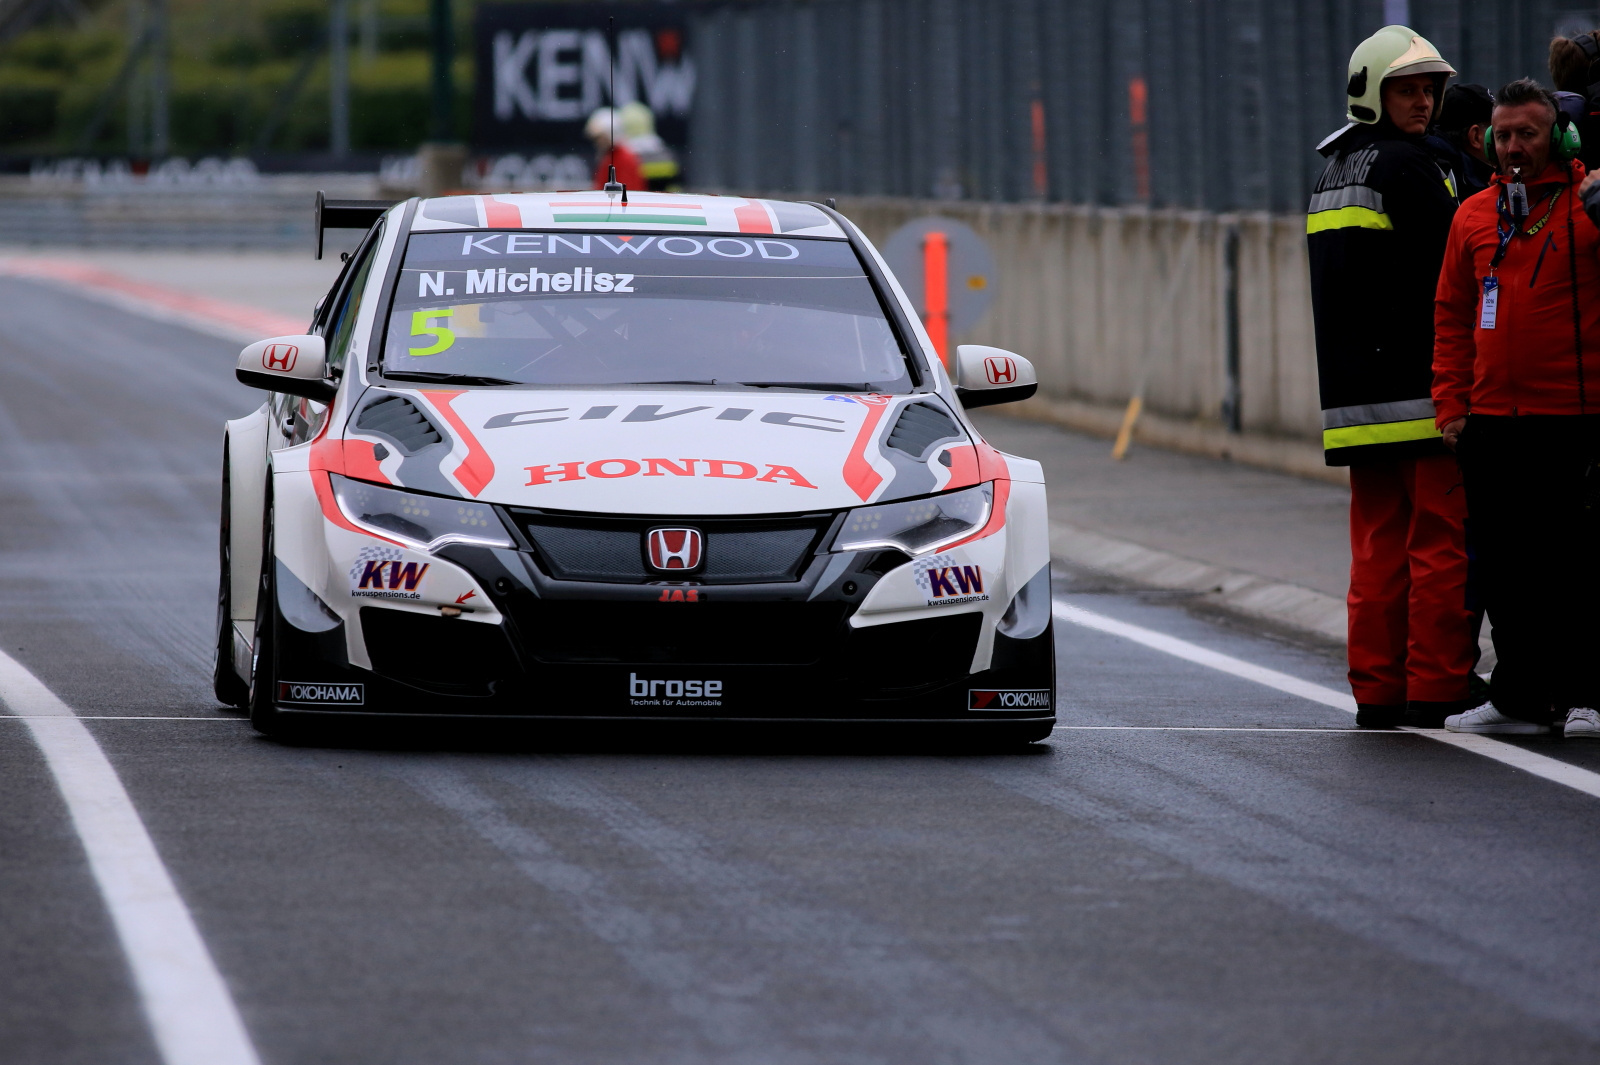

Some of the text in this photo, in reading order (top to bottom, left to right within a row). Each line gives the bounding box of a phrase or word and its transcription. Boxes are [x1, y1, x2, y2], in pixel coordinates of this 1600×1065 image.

[461, 234, 800, 261] KENWOOD
[419, 267, 634, 297] N. Michelisz
[408, 308, 455, 357] 5
[483, 404, 846, 433] CIVIC
[524, 457, 818, 490] HONDA
[358, 560, 430, 591] KW
[927, 564, 984, 598] KW
[351, 590, 420, 600] kwsuspensions.de
[658, 589, 699, 602] JAS
[927, 594, 989, 607] kwsuspensions.de
[290, 685, 361, 700] YOKOHAMA
[630, 672, 723, 697] brose
[629, 698, 661, 706] Technik
[998, 692, 1050, 707] YOKOHAMA
